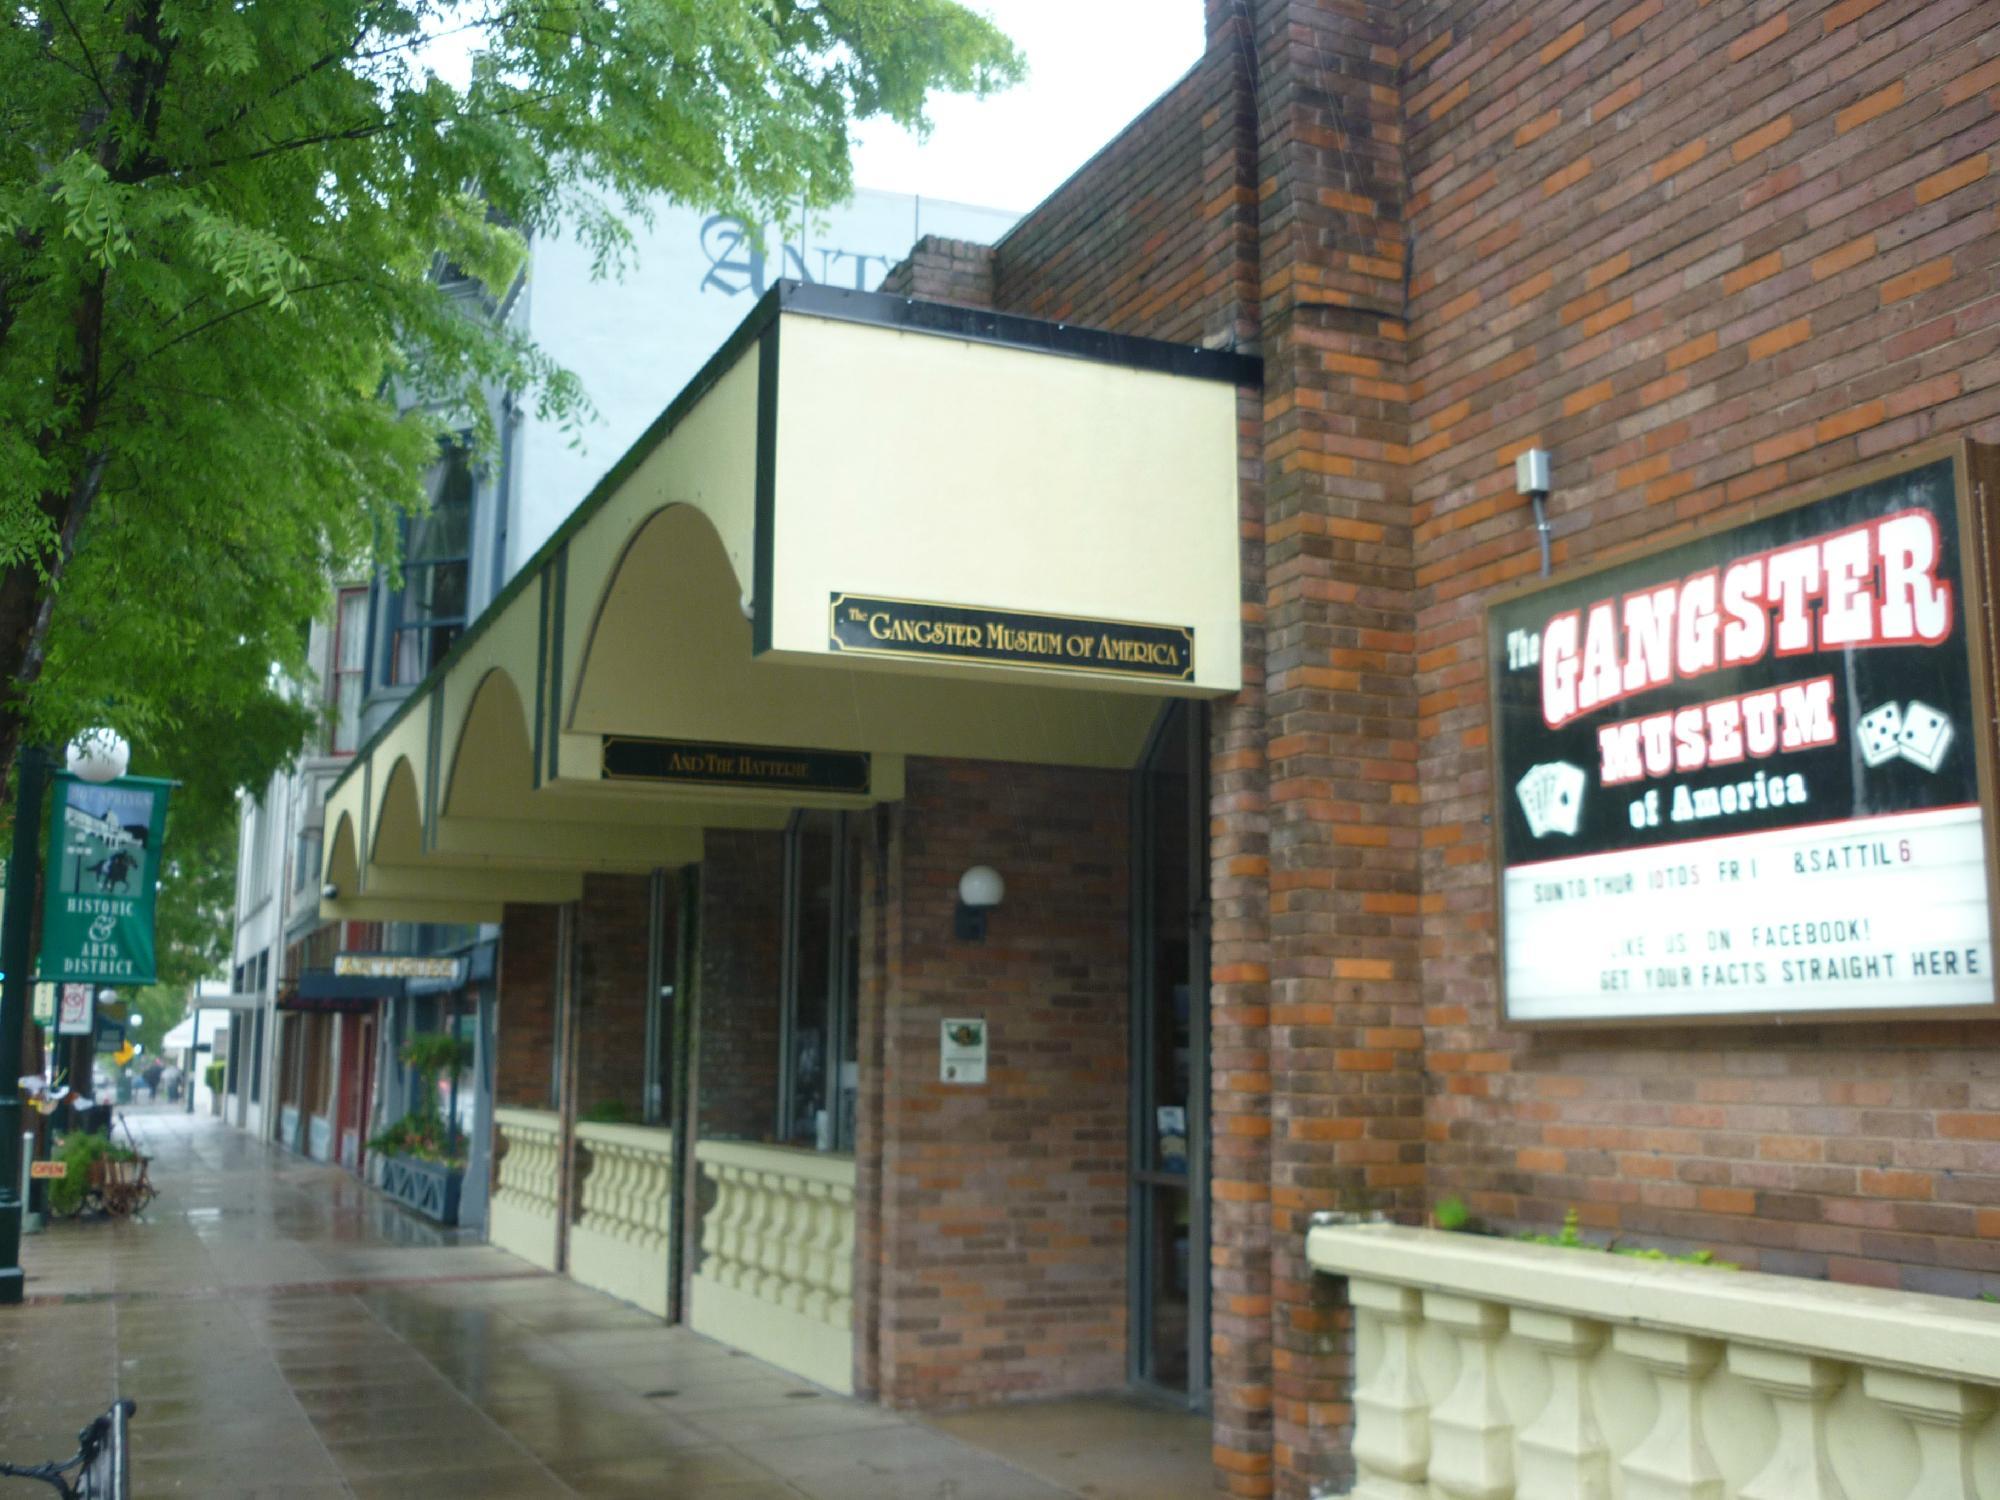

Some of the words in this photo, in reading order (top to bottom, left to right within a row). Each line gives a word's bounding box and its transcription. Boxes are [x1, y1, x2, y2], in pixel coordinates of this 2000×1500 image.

[699, 213, 903, 300] ANT
[848, 607, 868, 622] The
[869, 612, 982, 648] GANGSTER
[986, 622, 1063, 656] MUSEUM
[1065, 634, 1094, 658] OF
[1096, 633, 1180, 667] AMERICA
[1507, 628, 1541, 671] The
[1542, 508, 1952, 728] GANGSTER
[1598, 674, 1837, 787] MUSEUM
[1628, 788, 1660, 828] of
[1671, 770, 1808, 824] America
[1899, 839, 1912, 863] 6
[67, 897, 134, 917] HISTORIC
[88, 914, 117, 941] &
[1706, 928, 1732, 952] ON
[1751, 918, 1872, 948] FACEBOOK!
[63, 957, 134, 975] DISTRICT
[81, 942, 118, 958] ARTS
[1600, 967, 1629, 991] GET
[1644, 964, 1692, 990] YOUR
[1701, 960, 1768, 987] FACTS
[1782, 953, 1896, 984] STRAIGHT
[1911, 948, 1980, 977] HERE
